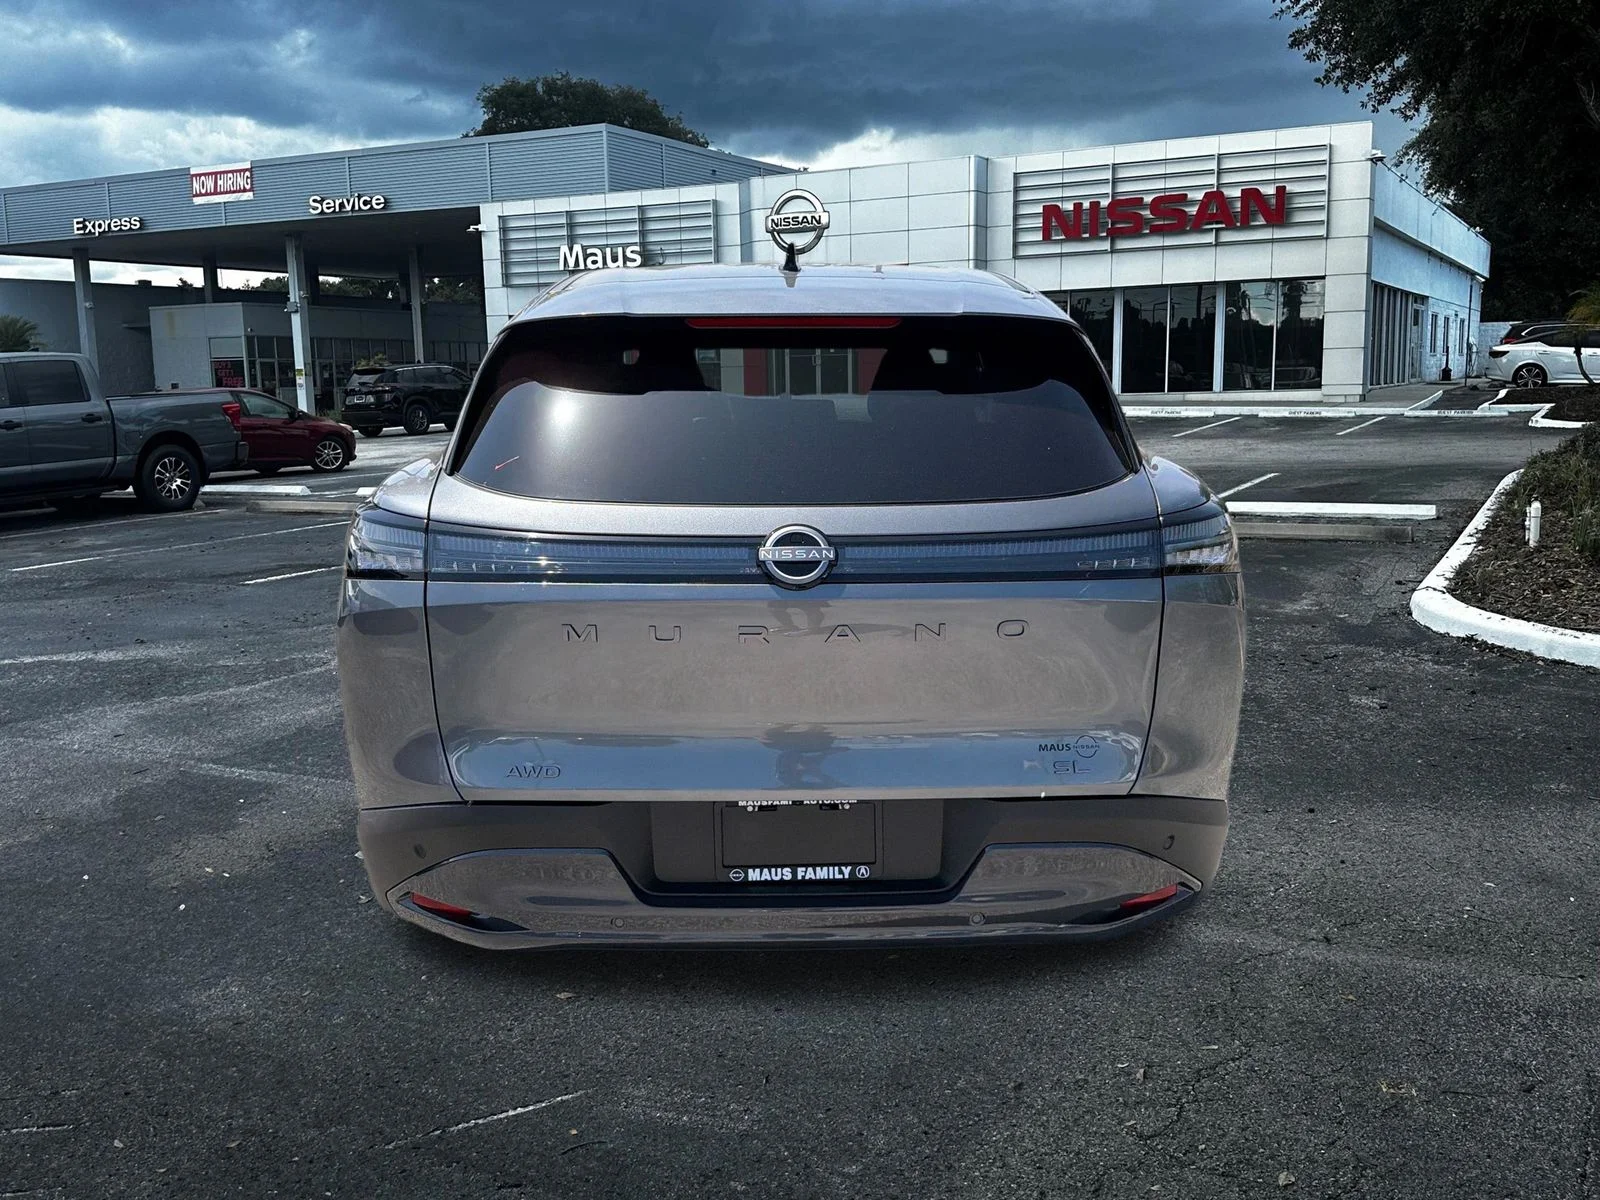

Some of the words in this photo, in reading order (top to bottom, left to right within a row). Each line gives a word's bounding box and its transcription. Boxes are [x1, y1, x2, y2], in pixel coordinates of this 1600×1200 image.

[193, 174, 214, 194] NOW
[217, 171, 251, 191] HIRING
[309, 193, 385, 214] Service
[771, 215, 821, 227] NISSAN
[1042, 185, 1287, 241] NISSAN
[73, 216, 141, 236] Express
[559, 243, 642, 271] Maus
[760, 549, 834, 559] NISSAN
[561, 619, 1030, 644] MURANO
[1039, 743, 1072, 752] MAUS
[506, 765, 561, 778] AWD
[1053, 760, 1090, 774] SL
[748, 868, 792, 881] MAUS
[797, 866, 852, 880] FAMILY
